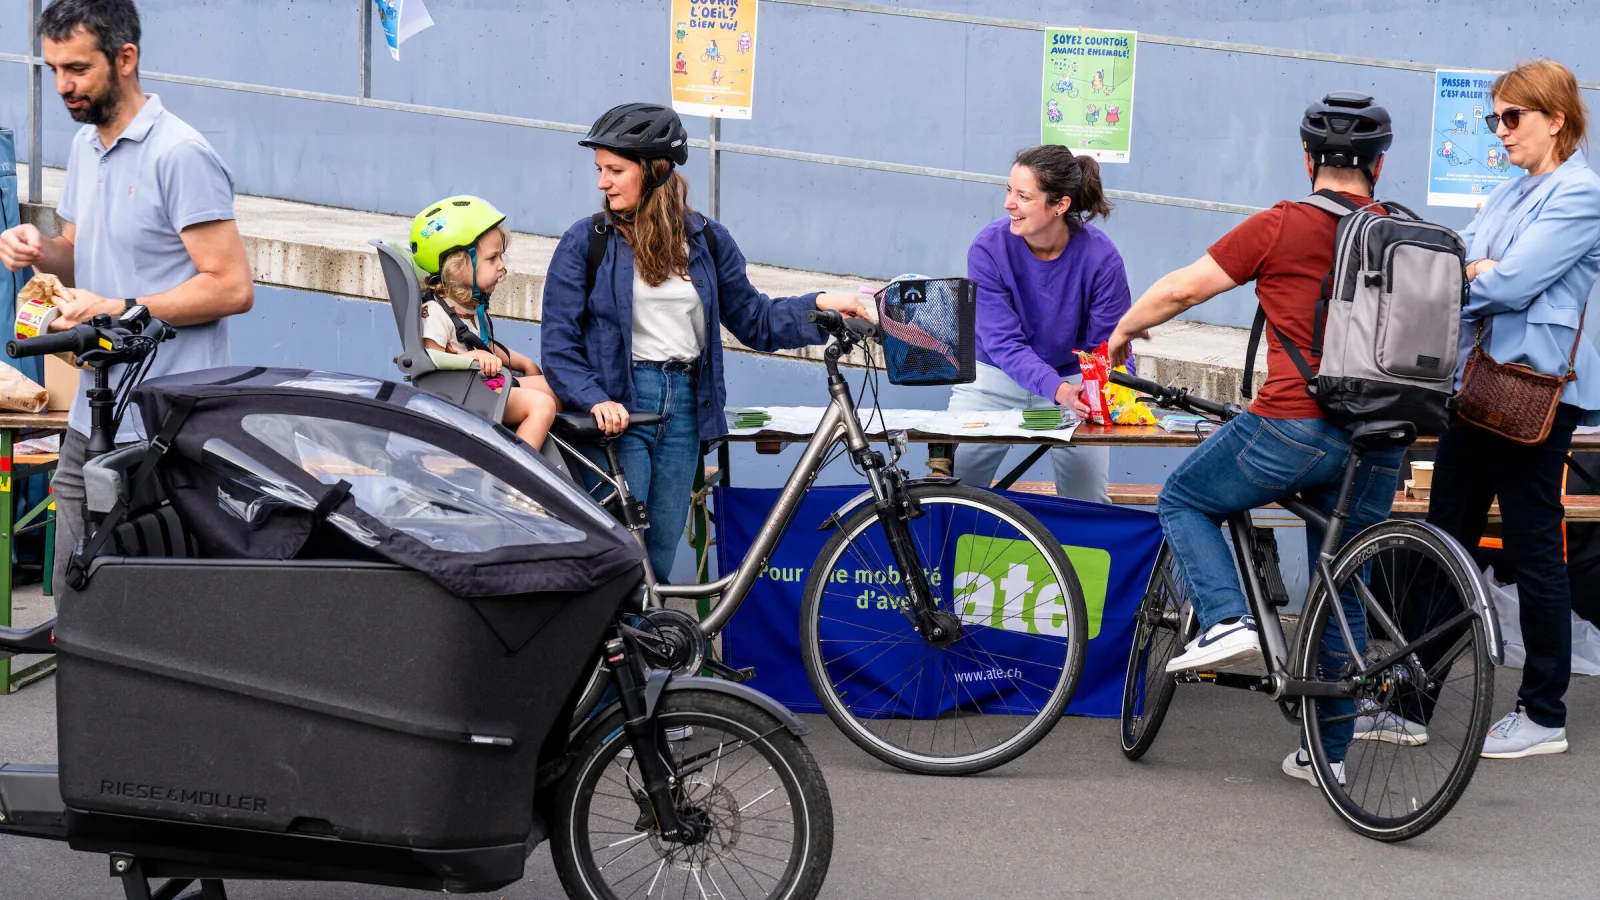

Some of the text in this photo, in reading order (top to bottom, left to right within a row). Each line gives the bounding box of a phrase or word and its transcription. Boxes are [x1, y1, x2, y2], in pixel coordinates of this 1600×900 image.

[1052, 34, 1082, 45] SOYEZ
[1050, 47, 1130, 59] AVANCEZ ENSEMBLE!
[1441, 78, 1471, 88] PASSER
[1440, 89, 1459, 98] C'EST
[1460, 90, 1483, 99] ALLER
[953, 562, 1069, 638] ate
[954, 667, 1022, 683] www.ate.ch
